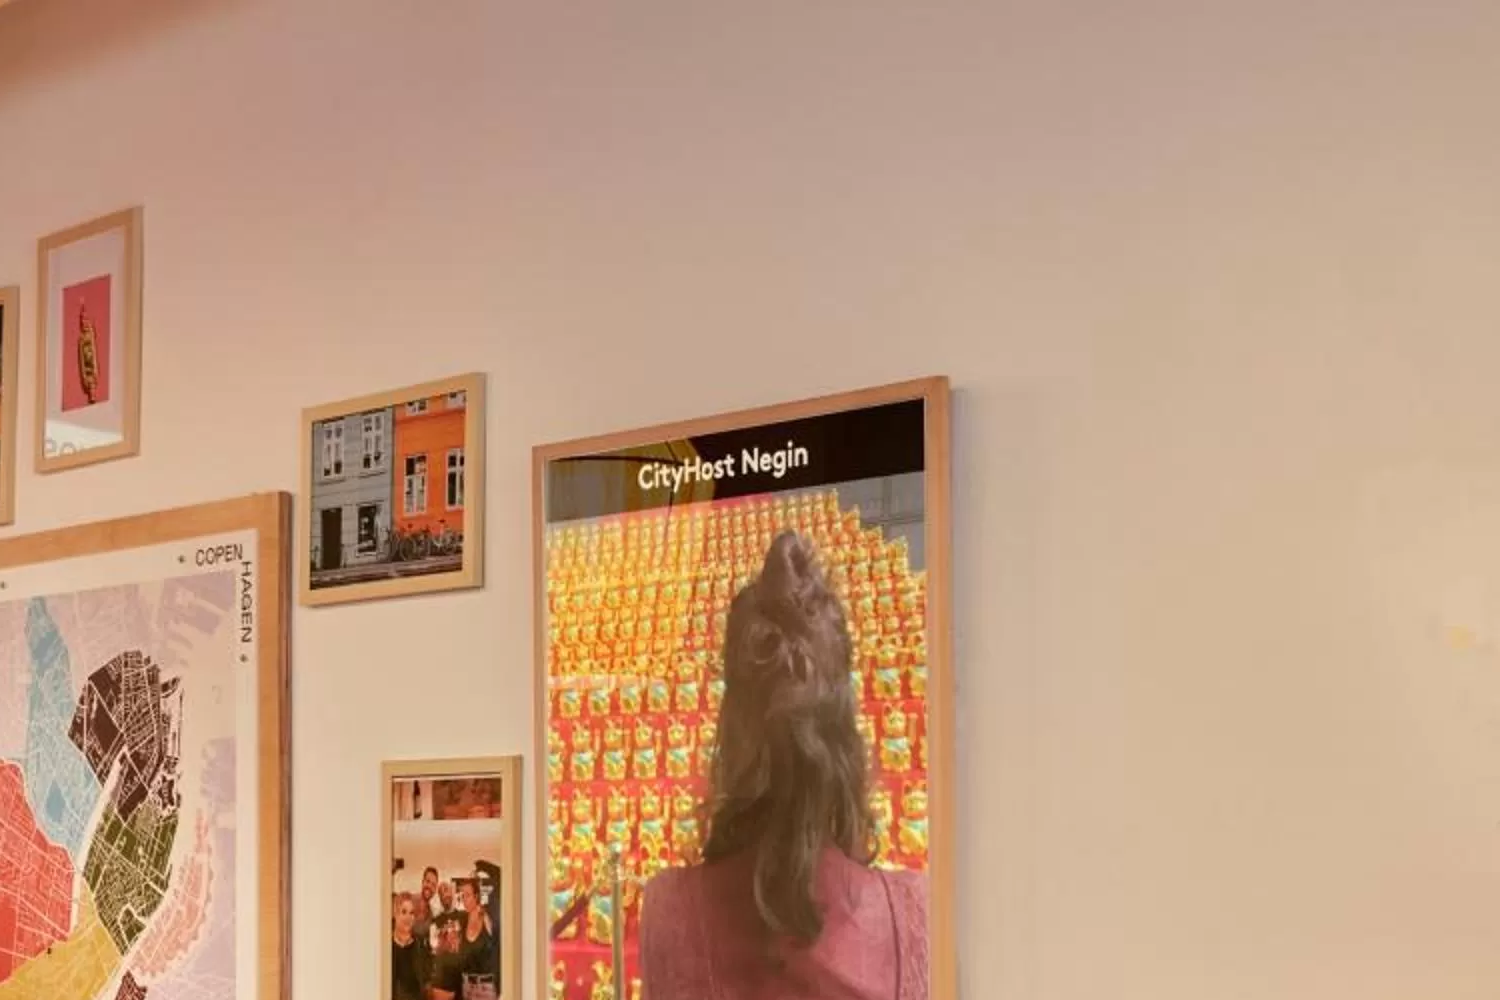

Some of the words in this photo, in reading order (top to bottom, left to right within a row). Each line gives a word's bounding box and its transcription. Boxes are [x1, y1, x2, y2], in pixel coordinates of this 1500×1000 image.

[638, 454, 735, 493] CityHost
[742, 441, 809, 479] Negin
[195, 543, 243, 566] COPEN
[240, 561, 253, 643] HAGEN
